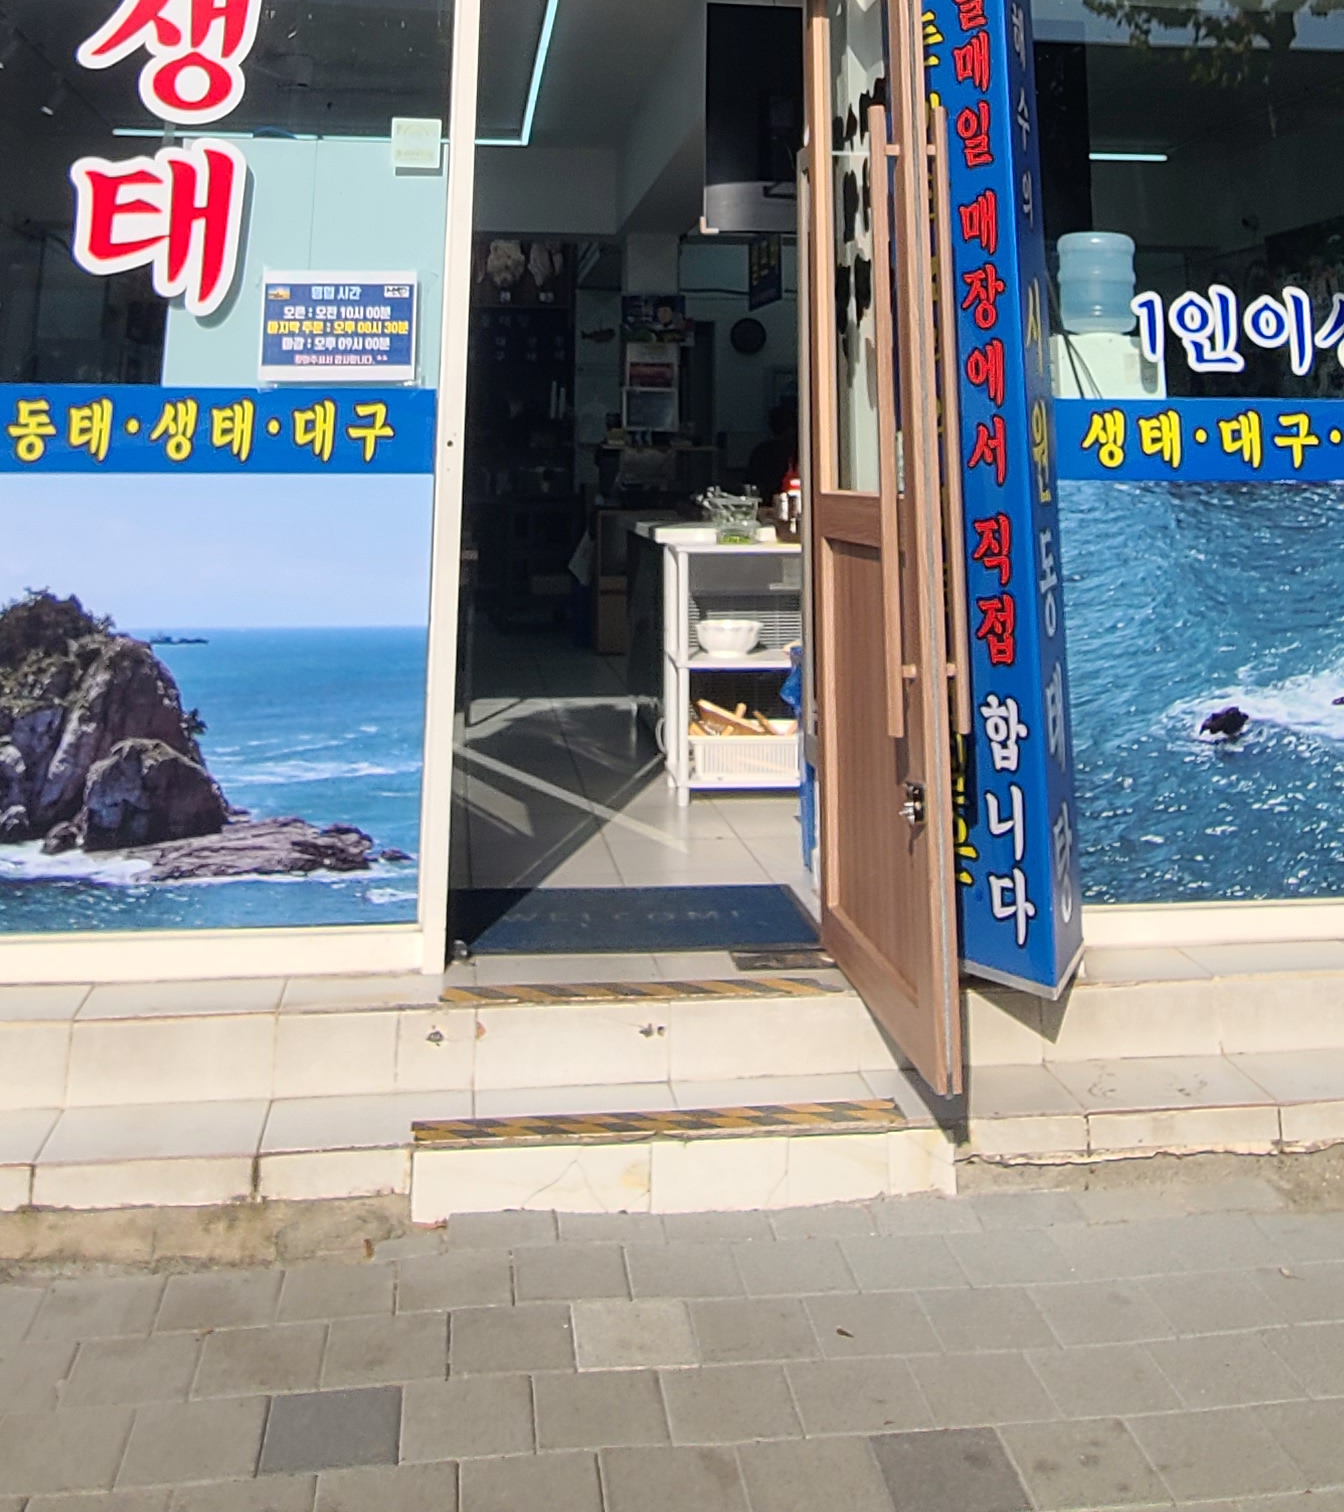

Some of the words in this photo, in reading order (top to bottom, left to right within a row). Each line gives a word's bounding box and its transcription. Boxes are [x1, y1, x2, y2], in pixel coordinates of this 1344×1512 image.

[337, 285, 362, 300] 시간
[315, 306, 337, 319] 오전
[340, 306, 364, 319] 10시
[333, 321, 355, 334] 오후
[338, 337, 362, 350] 09시
[972, 510, 1017, 668] 직접
[979, 692, 1038, 947] 합니다
